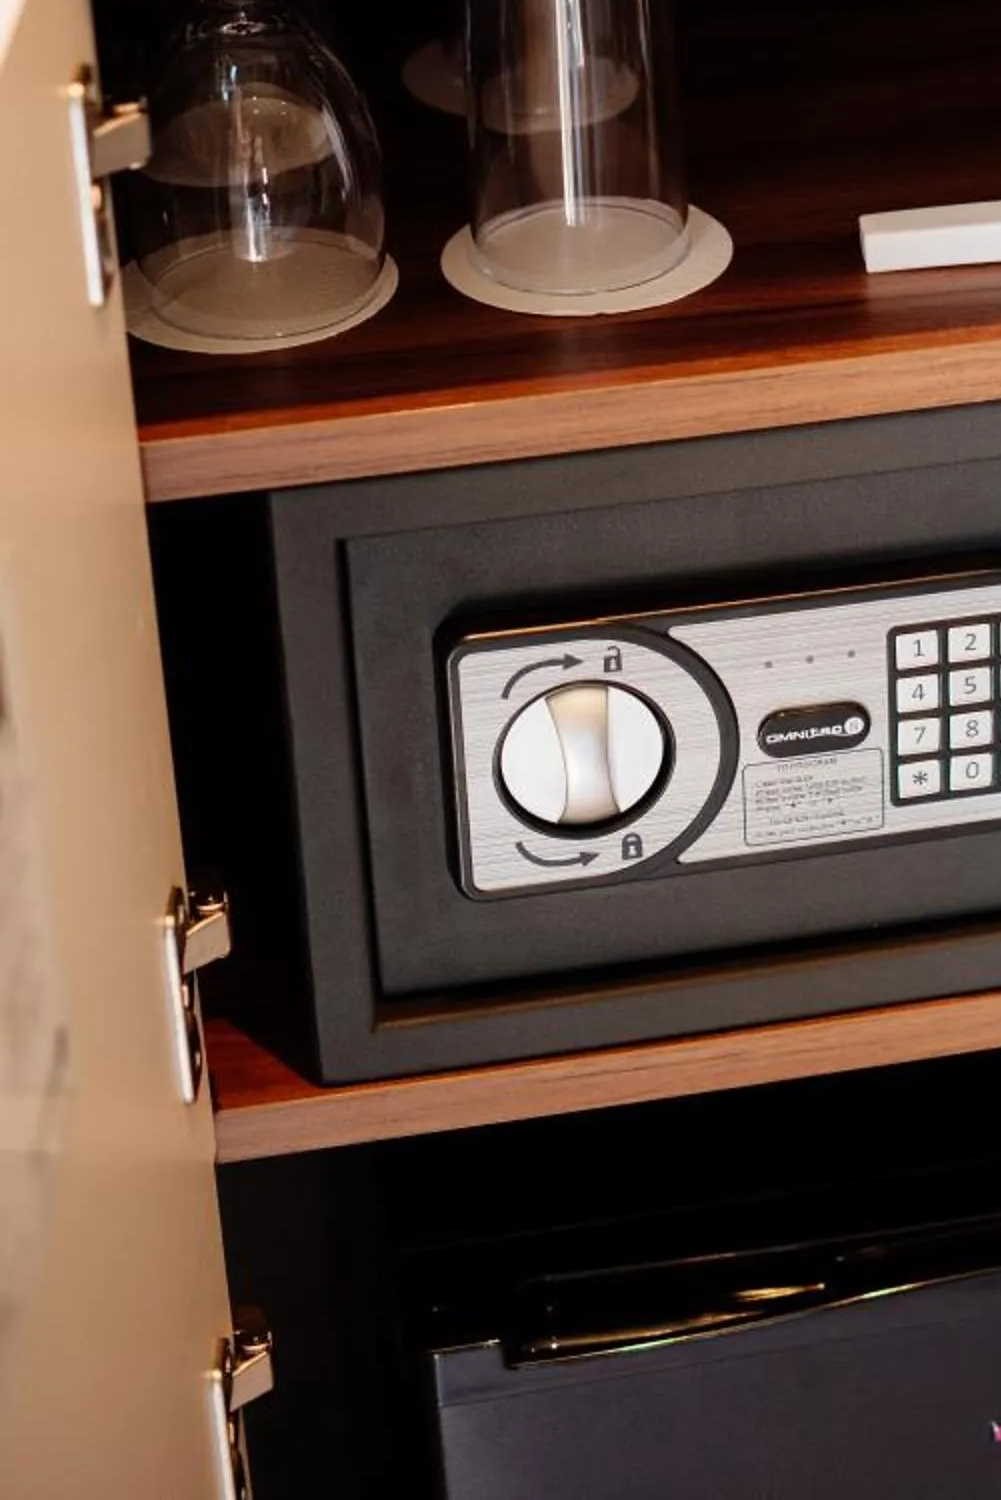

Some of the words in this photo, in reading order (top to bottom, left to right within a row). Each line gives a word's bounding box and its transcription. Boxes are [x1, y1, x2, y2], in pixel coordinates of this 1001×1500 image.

[913, 638, 925, 657] 1
[964, 632, 977, 651] 2
[911, 683, 926, 700] 4
[964, 676, 977, 694] 5
[913, 726, 926, 744] 7
[966, 719, 979, 738] 8
[965, 761, 979, 779] 0
